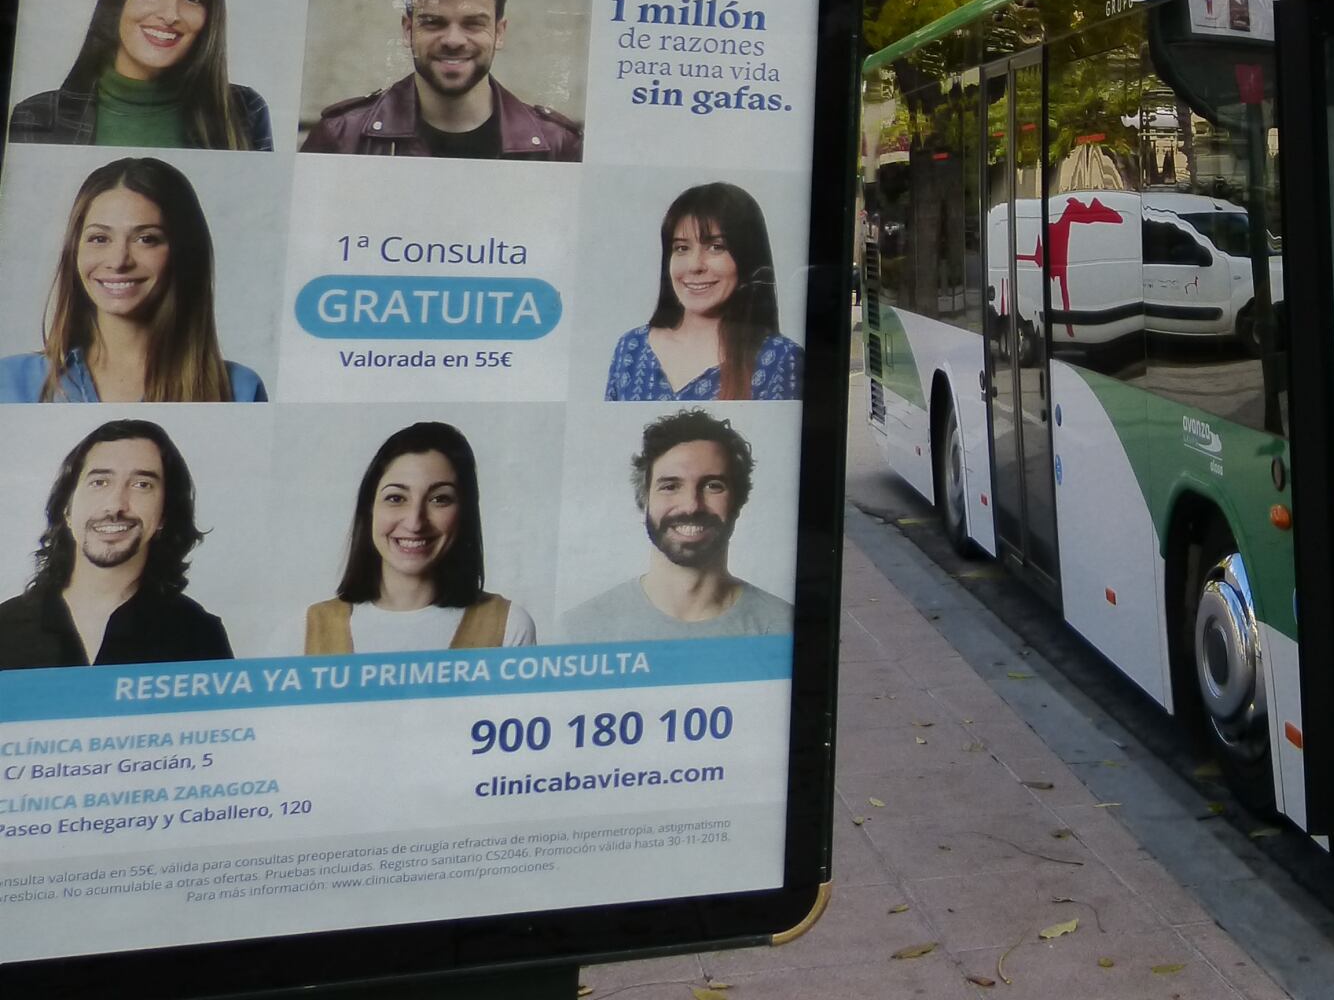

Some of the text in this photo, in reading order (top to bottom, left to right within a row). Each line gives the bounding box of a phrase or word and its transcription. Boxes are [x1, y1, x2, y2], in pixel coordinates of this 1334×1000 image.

[618, 27, 765, 57] de razones
[616, 58, 781, 82] para una vida
[631, 79, 793, 115] sin gafas.
[337, 234, 528, 265] 1ª Consulta
[317, 288, 542, 325] GRATUITA
[339, 350, 513, 368] Valorada en 55€
[1182, 415, 1211, 441] avanza
[114, 651, 651, 701] RESERVA YA TU PRIMERA CONSULTA
[1, 726, 256, 757] CLÍNICA BAVIERA HUESCA
[470, 705, 734, 755] 900 180 100
[4, 752, 214, 781] C/ Baltasar Gracián, 5
[474, 763, 726, 798] clinicabaviera.com
[83, 786, 169, 808] BAVIERA
[174, 779, 281, 802] ZARAGOZA
[58, 812, 158, 834] Echegaray
[161, 813, 174, 830] y
[180, 804, 274, 824] Caballero,
[280, 799, 313, 816] 120
[49, 869, 106, 885] valorada
[110, 868, 127, 880] en
[203, 859, 232, 874] para
[235, 854, 295, 869] consultas
[298, 845, 390, 864] preoperatorias
[391, 843, 407, 855] de
[452, 834, 508, 850] refractiva
[510, 833, 525, 846] de
[657, 818, 732, 835] astigmatismo
[63, 886, 83, 899] No
[85, 879, 163, 897] acumulable
[164, 880, 174, 890] a
[176, 876, 211, 889] otras
[265, 866, 317, 881] Pruebas
[380, 857, 428, 873] Registro
[431, 851, 483, 866] sanitario
[535, 842, 597, 858] Promoción
[634, 835, 665, 850] hasta
[186, 889, 216, 903] Para
[219, 885, 247, 900] más
